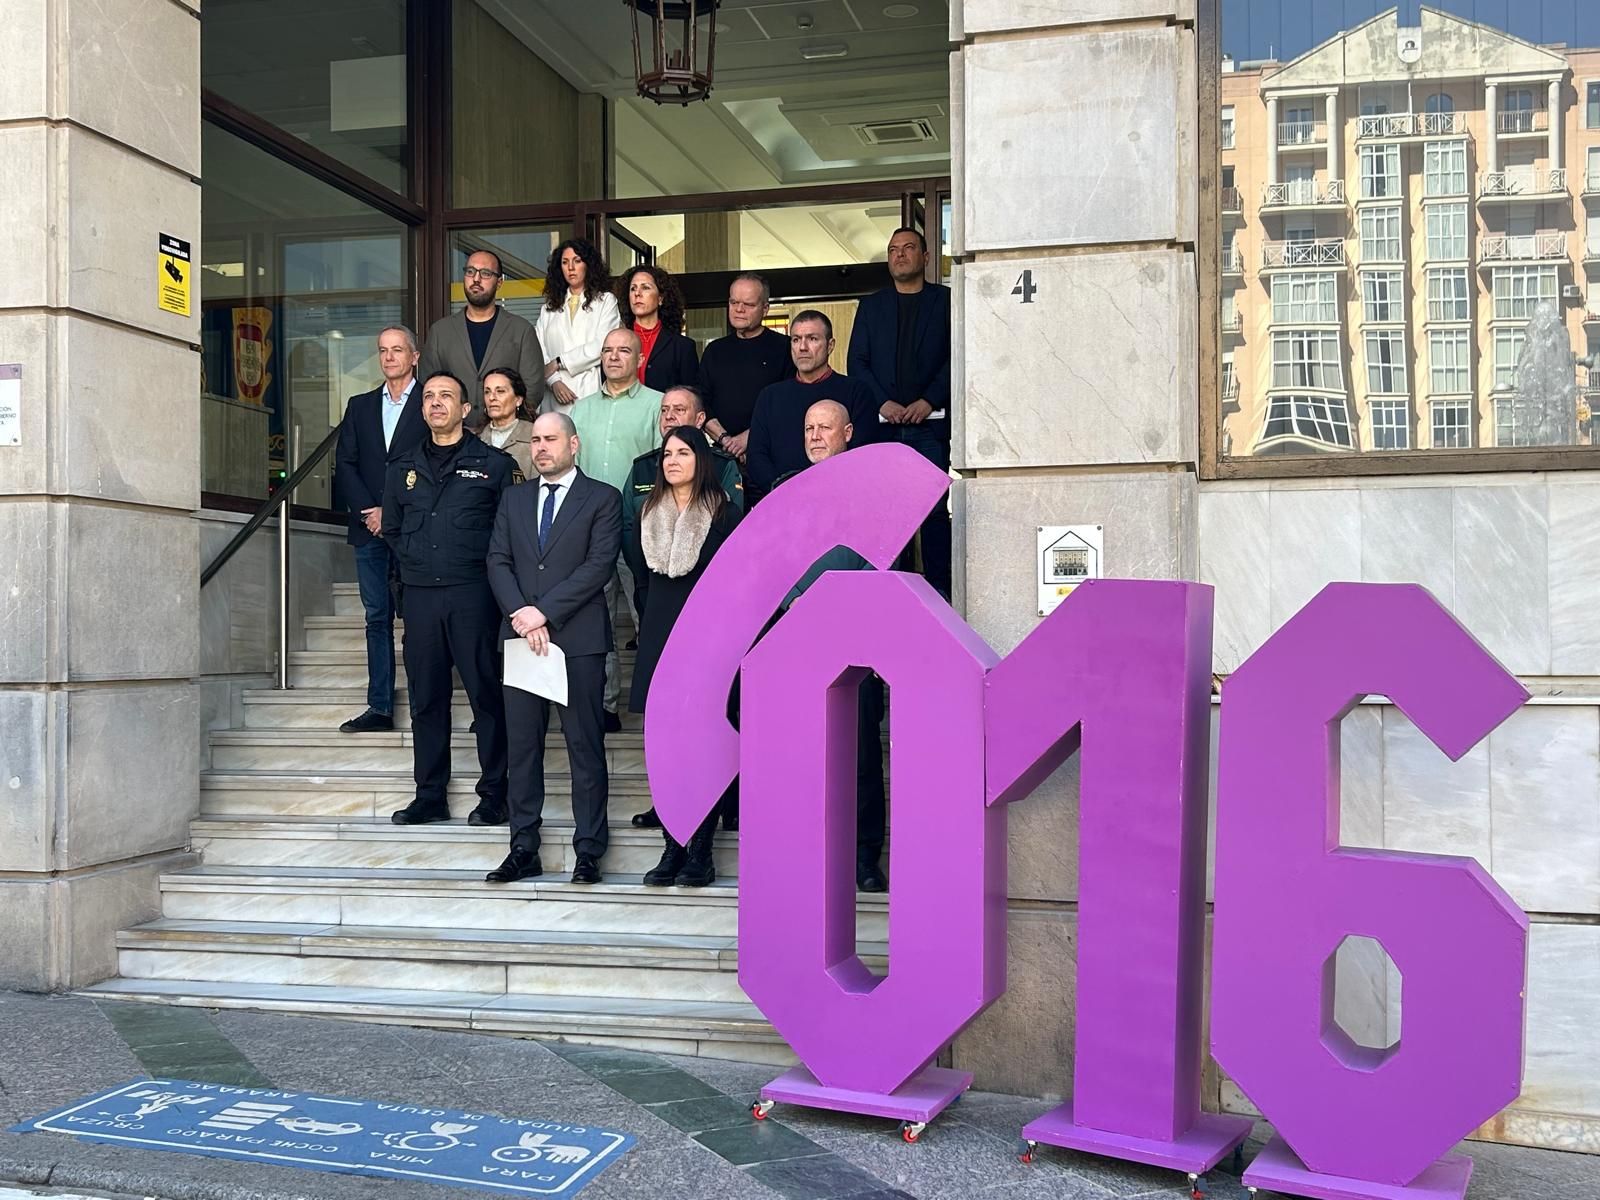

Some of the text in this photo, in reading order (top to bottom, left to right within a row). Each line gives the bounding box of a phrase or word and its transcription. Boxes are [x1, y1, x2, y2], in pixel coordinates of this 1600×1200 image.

[1010, 269, 1037, 304] 4
[738, 570, 1530, 1186] 016
[186, 1083, 299, 1099] ARASAAC
[67, 1115, 145, 1130] CRUZA
[377, 1103, 587, 1134] CIUDAD DE CEUTA
[167, 1128, 339, 1153] COCHE PARADO
[370, 1151, 434, 1165] MIRA
[481, 1165, 557, 1182] PARA
